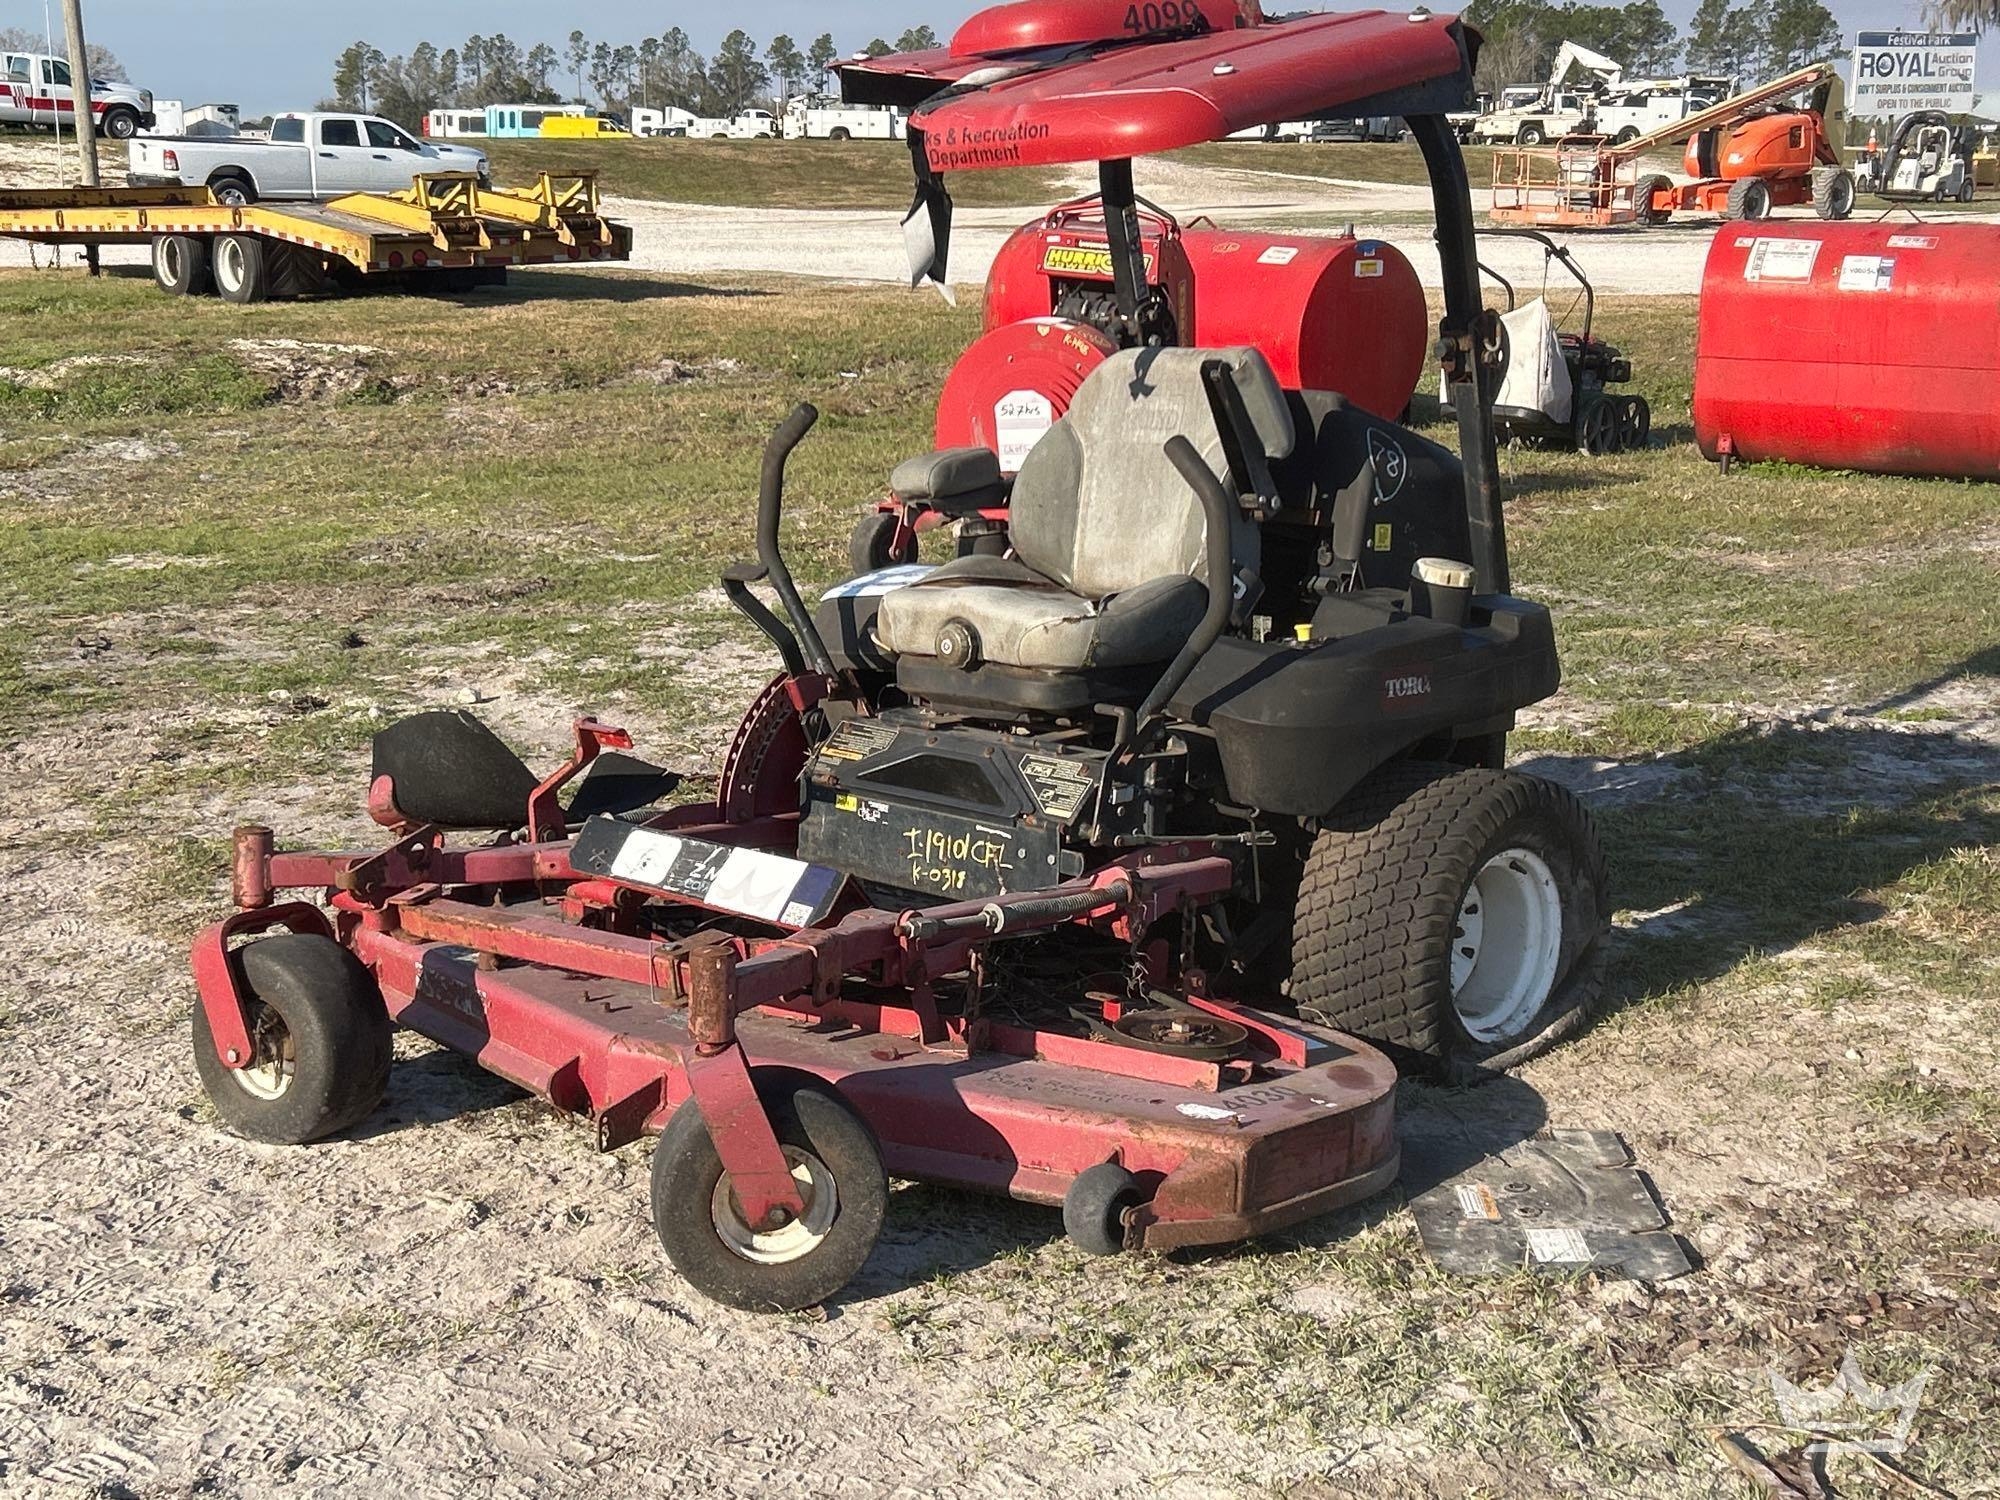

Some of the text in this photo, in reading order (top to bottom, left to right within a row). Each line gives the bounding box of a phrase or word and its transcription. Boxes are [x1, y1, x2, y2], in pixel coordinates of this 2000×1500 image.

[1888, 35, 1926, 45] Festival
[1859, 52, 1936, 77] ROYAL
[1932, 53, 1973, 64] Auction
[1938, 66, 1972, 78] Group
[1876, 84, 1901, 94] SURPLUS
[1948, 83, 1972, 93] AUCTION
[1877, 98, 1952, 109] OPEN TO THE PUBLIC
[946, 128, 956, 145] &
[962, 121, 1049, 144] Recreation
[929, 143, 1020, 168] Department
[1222, 1086, 1304, 1110] 4030
